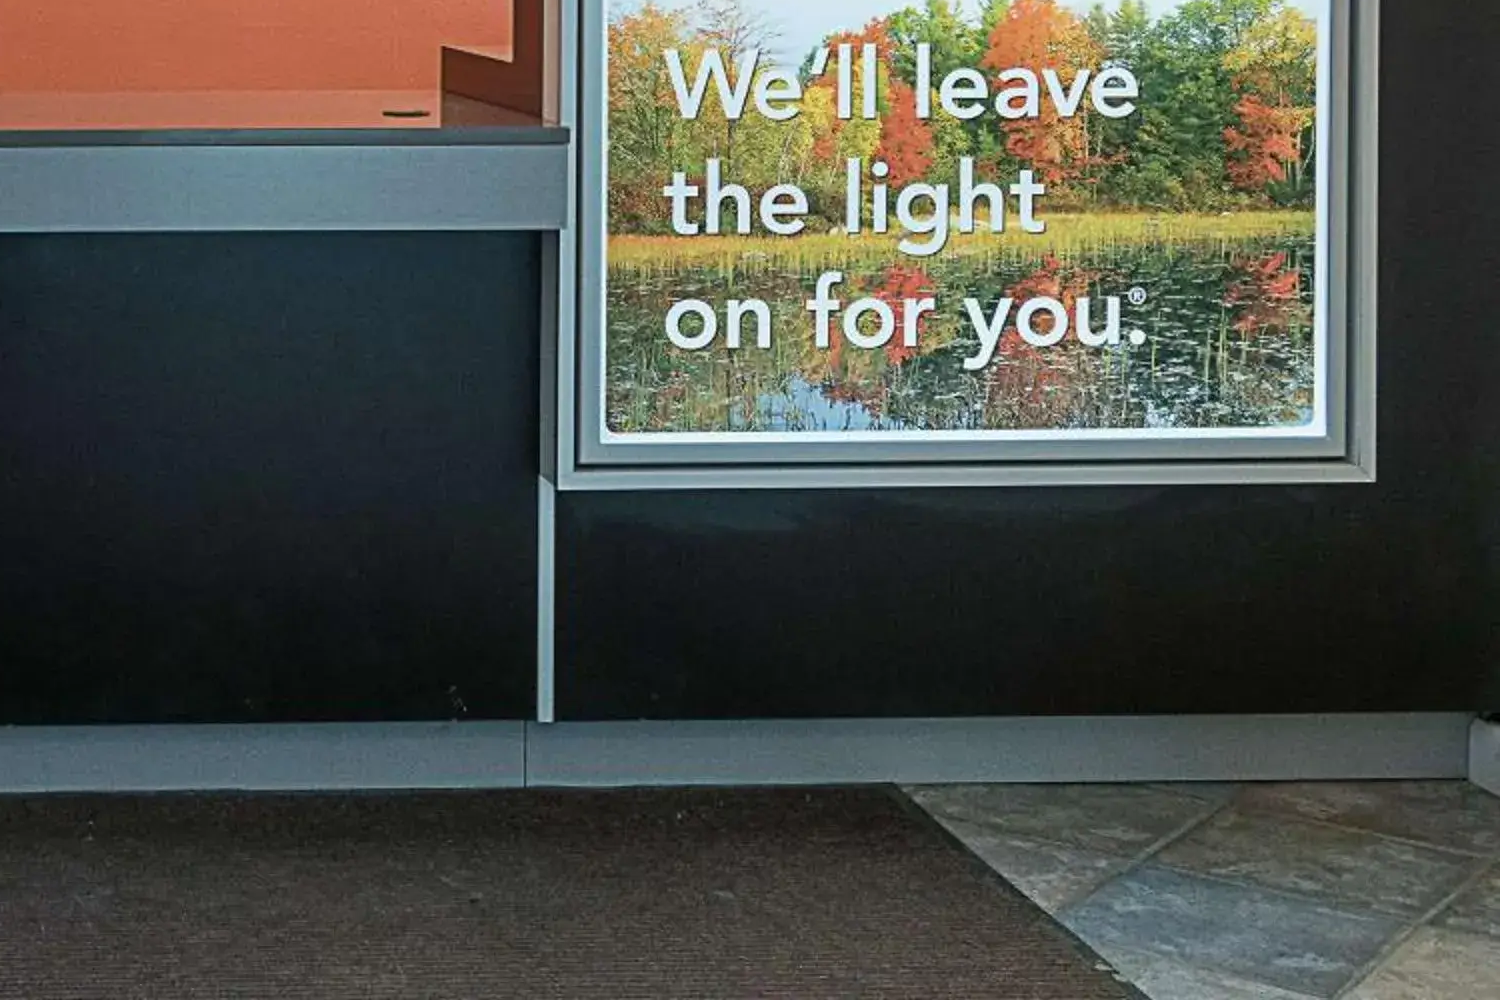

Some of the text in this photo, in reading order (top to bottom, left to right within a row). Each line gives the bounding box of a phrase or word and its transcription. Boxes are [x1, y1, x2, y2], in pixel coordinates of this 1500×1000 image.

[664, 43, 1140, 121] We'll leave
[663, 157, 1047, 257] the light
[665, 296, 772, 351] on
[806, 271, 936, 350] for
